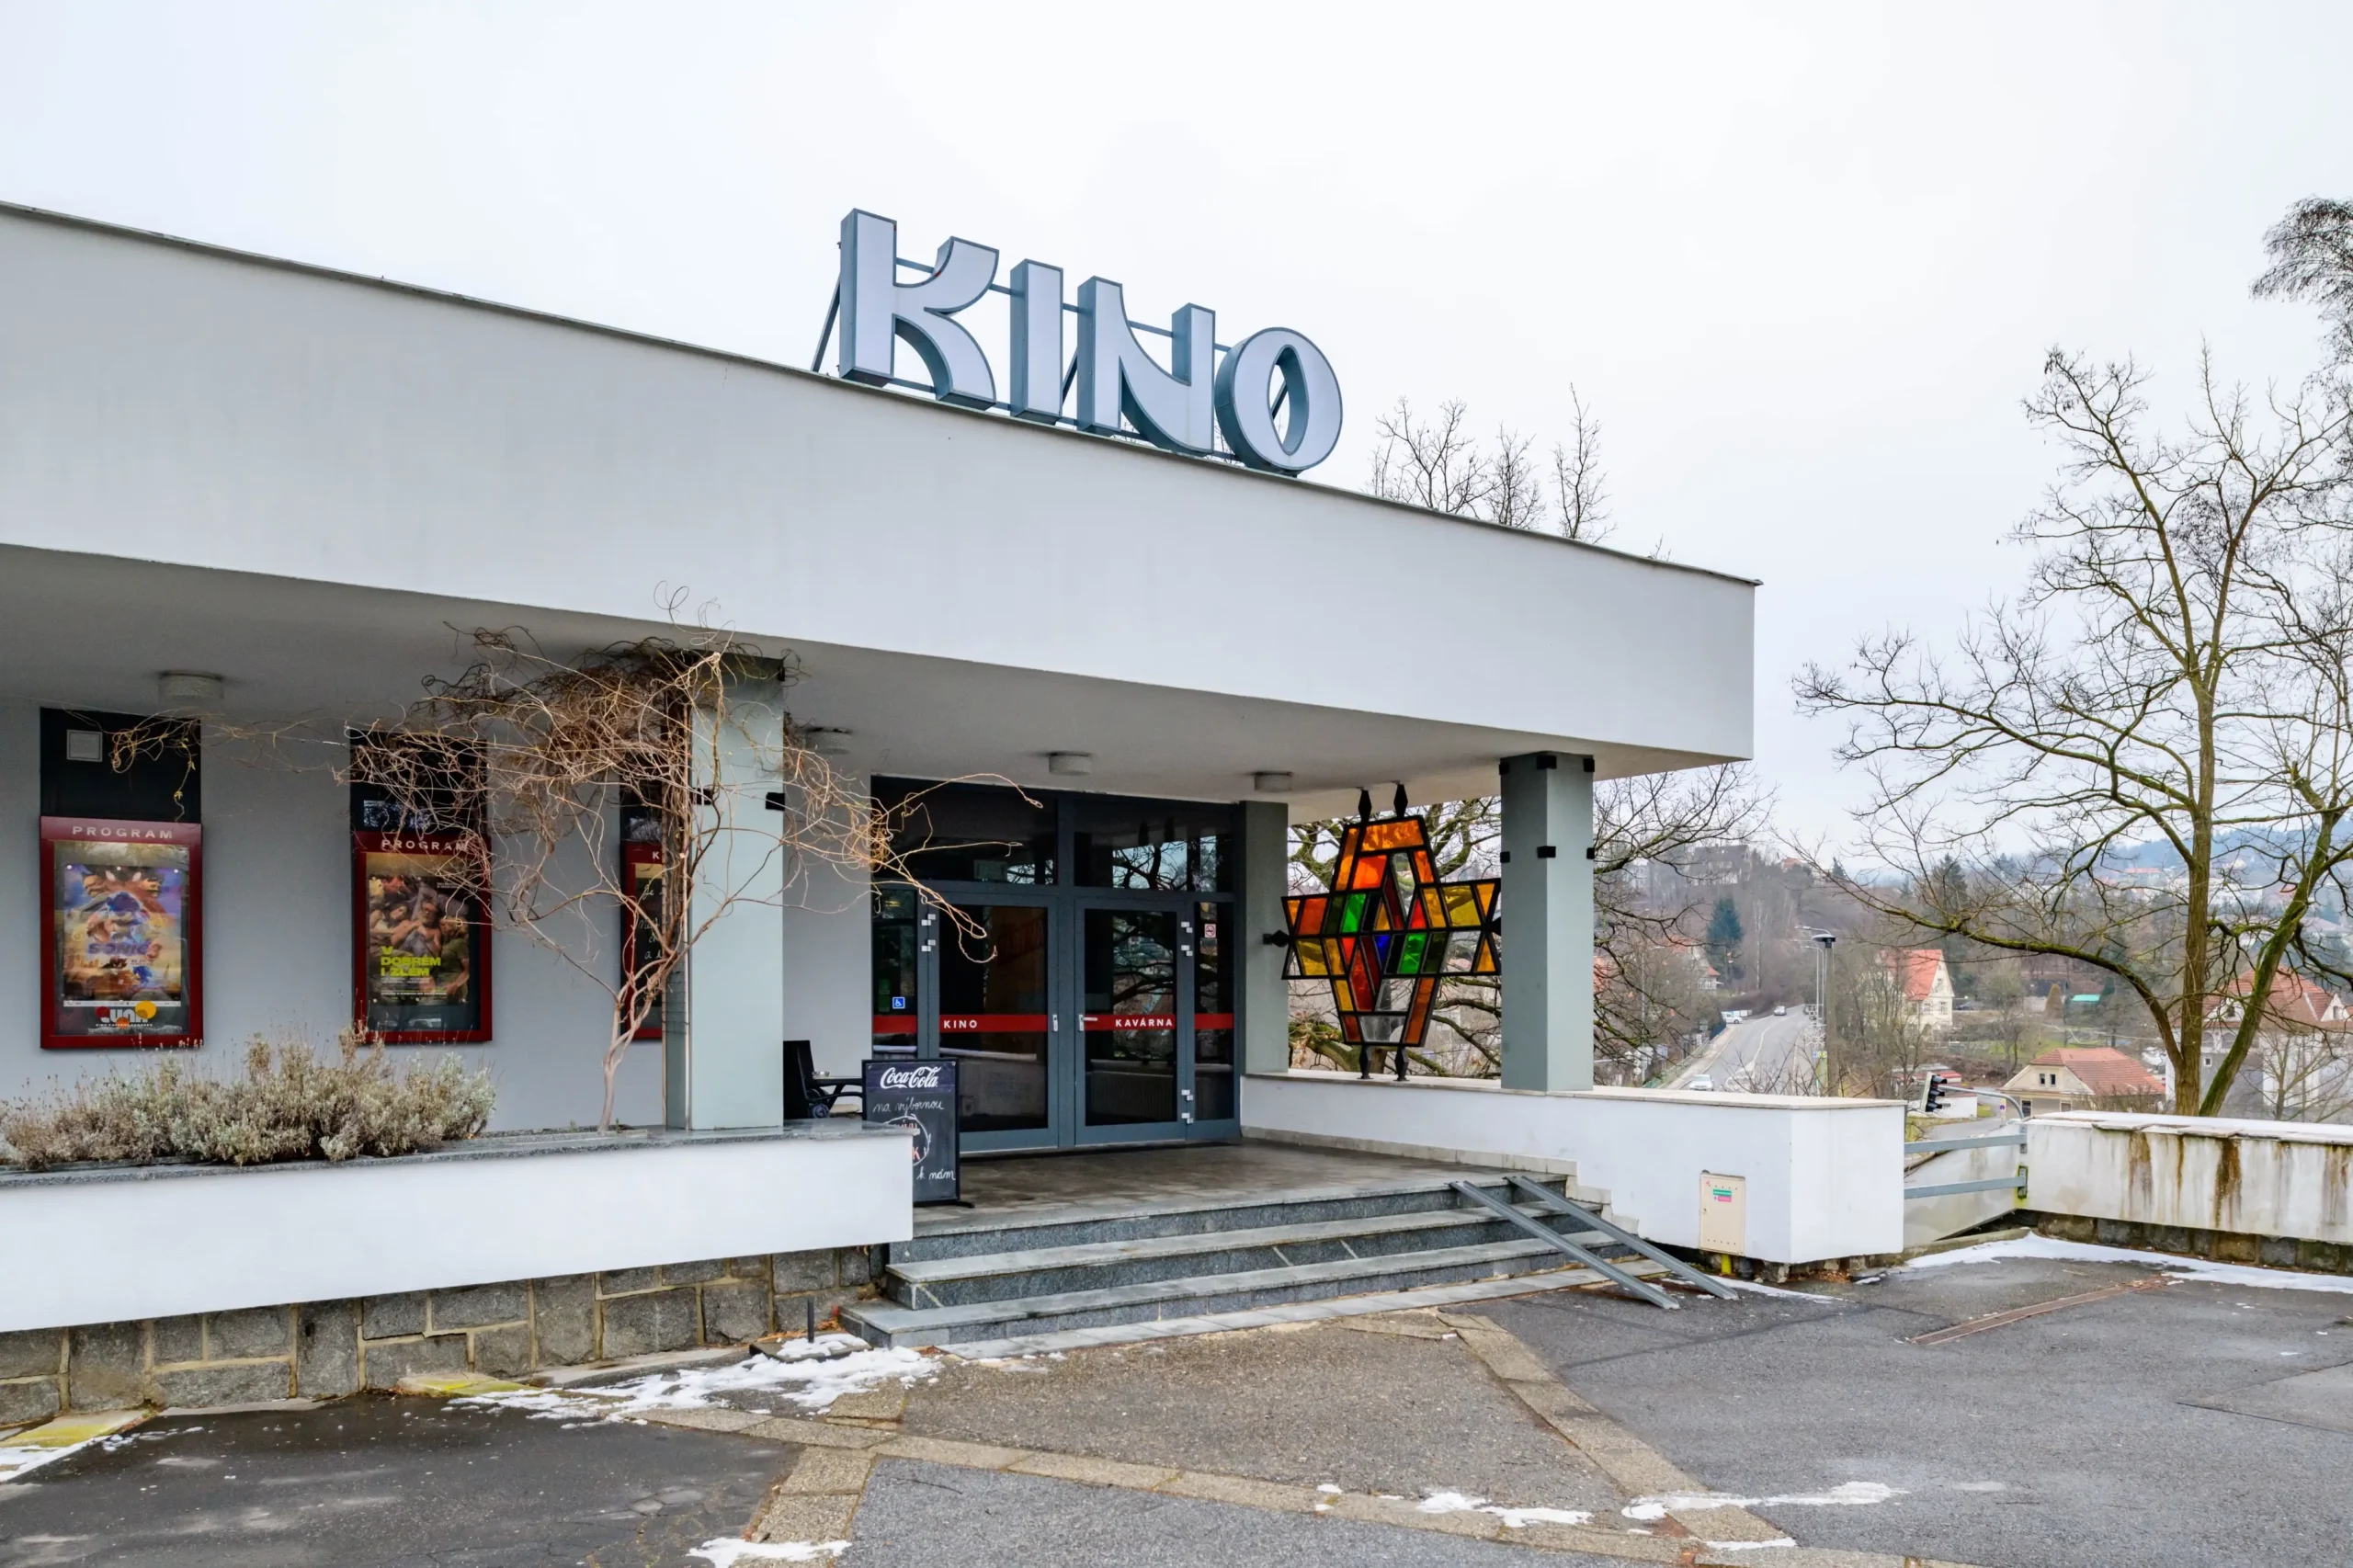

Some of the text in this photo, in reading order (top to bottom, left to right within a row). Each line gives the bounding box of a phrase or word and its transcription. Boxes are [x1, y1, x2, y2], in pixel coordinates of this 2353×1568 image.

[840, 208, 1343, 476] KINO
[72, 825, 173, 839] PROGRAM
[381, 838, 468, 851] PROGRAM
[381, 946, 393, 955] V
[381, 955, 441, 966] DOBRÉM
[943, 1019, 978, 1028] KINO
[1115, 1017, 1173, 1028] KAVÁRNA
[880, 1066, 941, 1088] Coca-Cola
[872, 1096, 945, 1115] na výbornou
